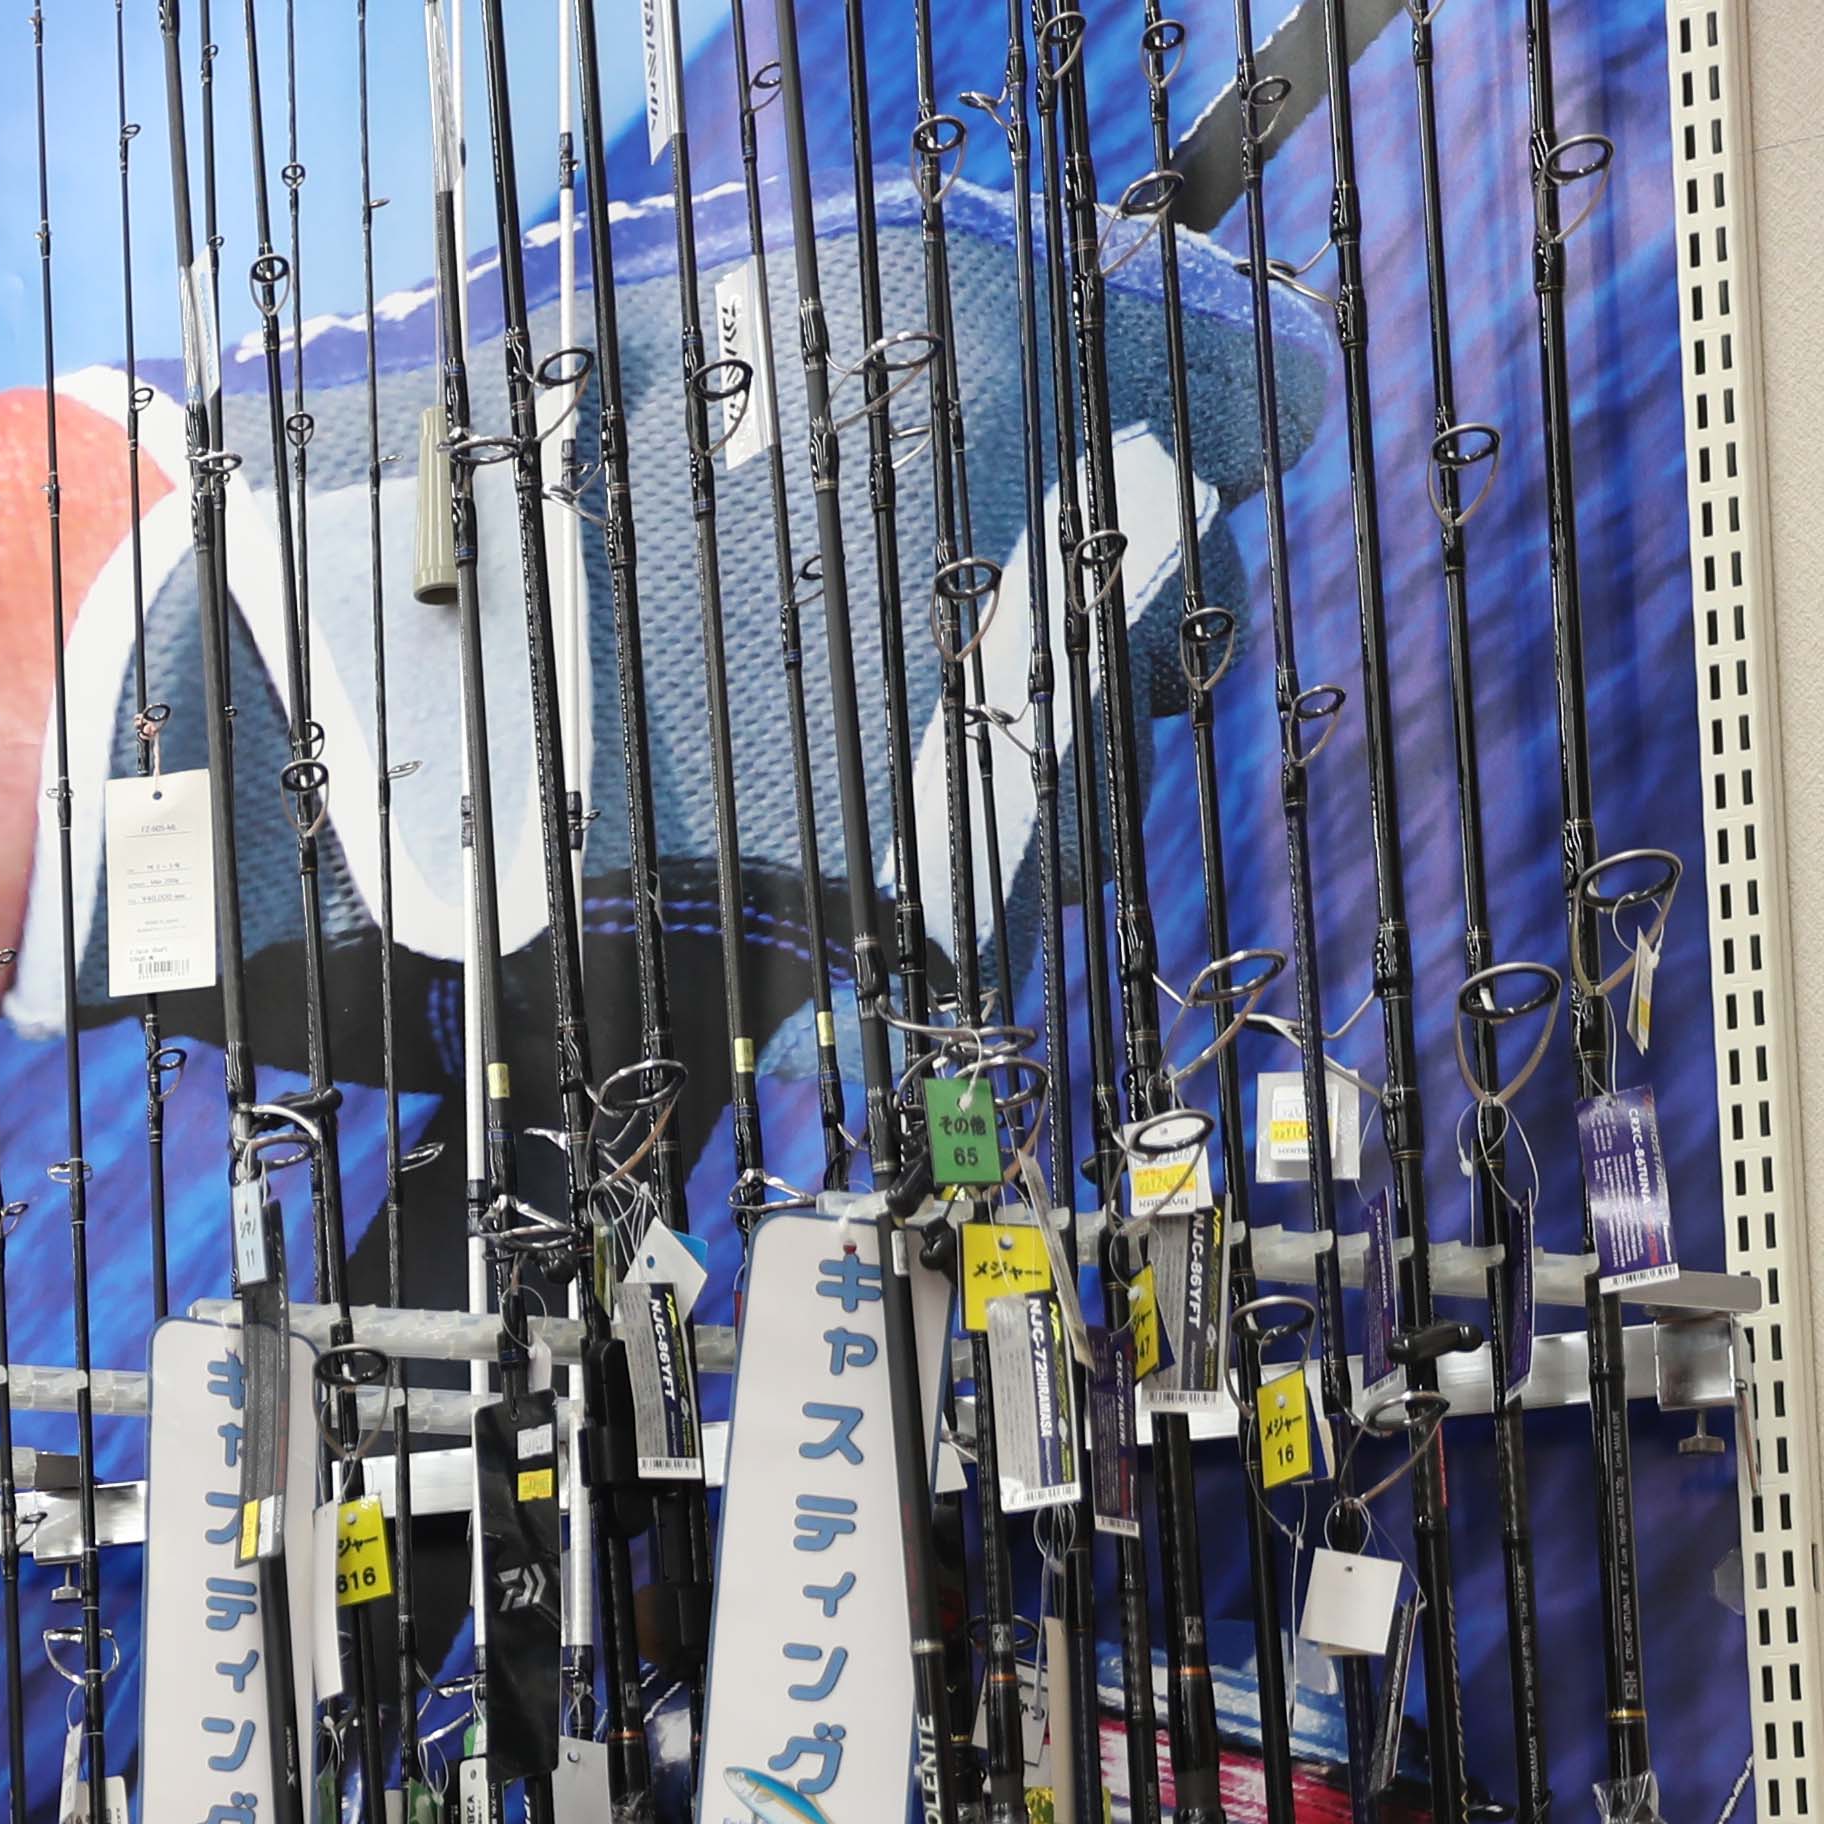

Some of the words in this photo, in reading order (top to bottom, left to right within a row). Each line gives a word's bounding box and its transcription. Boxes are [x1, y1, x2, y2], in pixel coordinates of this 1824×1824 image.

[939, 1115, 988, 1137] その他
[953, 1148, 979, 1167] 65
[972, 1260, 1043, 1280] メジャー
[649, 1298, 676, 1400] NJC-86YFT
[1276, 1445, 1295, 1466] 16
[768, 1252, 885, 1797] キャスティング
[338, 1534, 379, 1558] ジャー
